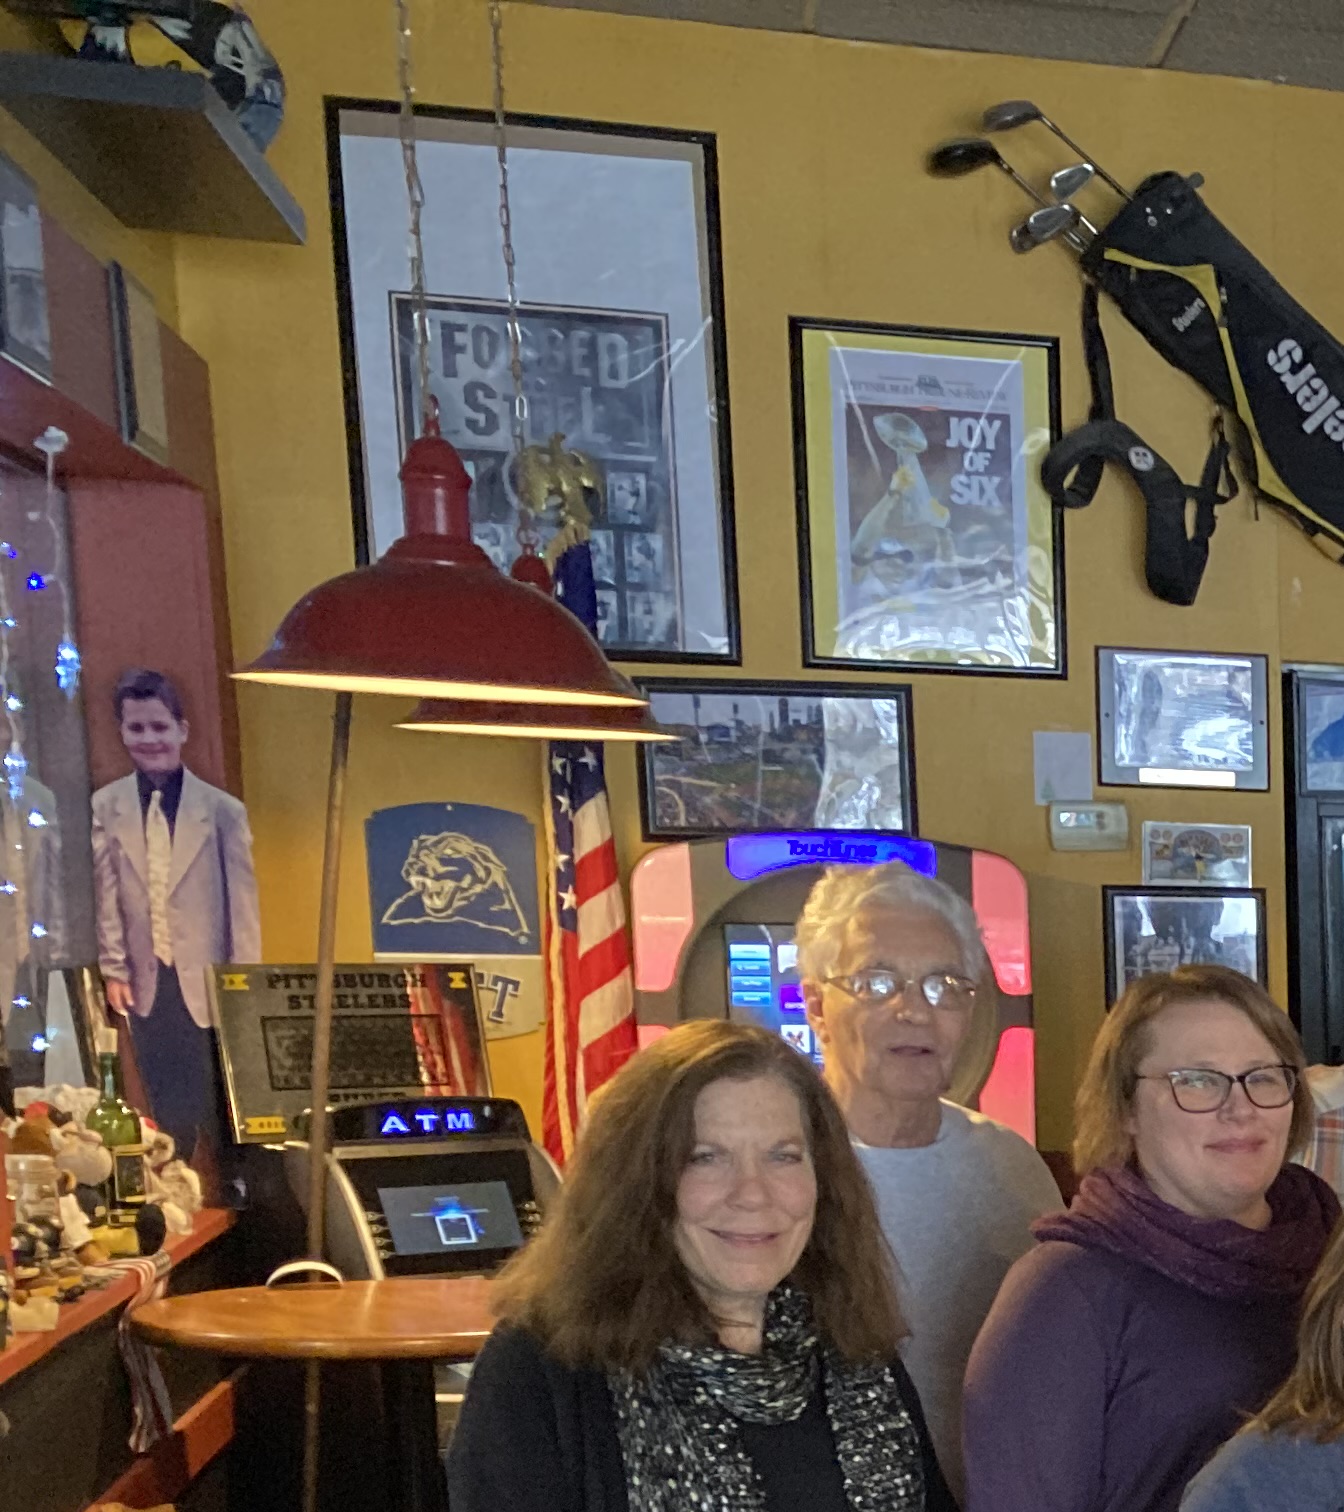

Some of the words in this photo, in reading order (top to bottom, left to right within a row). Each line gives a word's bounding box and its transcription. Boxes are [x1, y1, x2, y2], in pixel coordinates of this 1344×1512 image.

[946, 416, 1002, 450] JOY
[963, 451, 993, 473] OF
[950, 474, 1002, 507] SIX
[786, 839, 878, 858] TouchTunes
[287, 994, 410, 1011] STELERS
[381, 1110, 475, 1134] ATM
